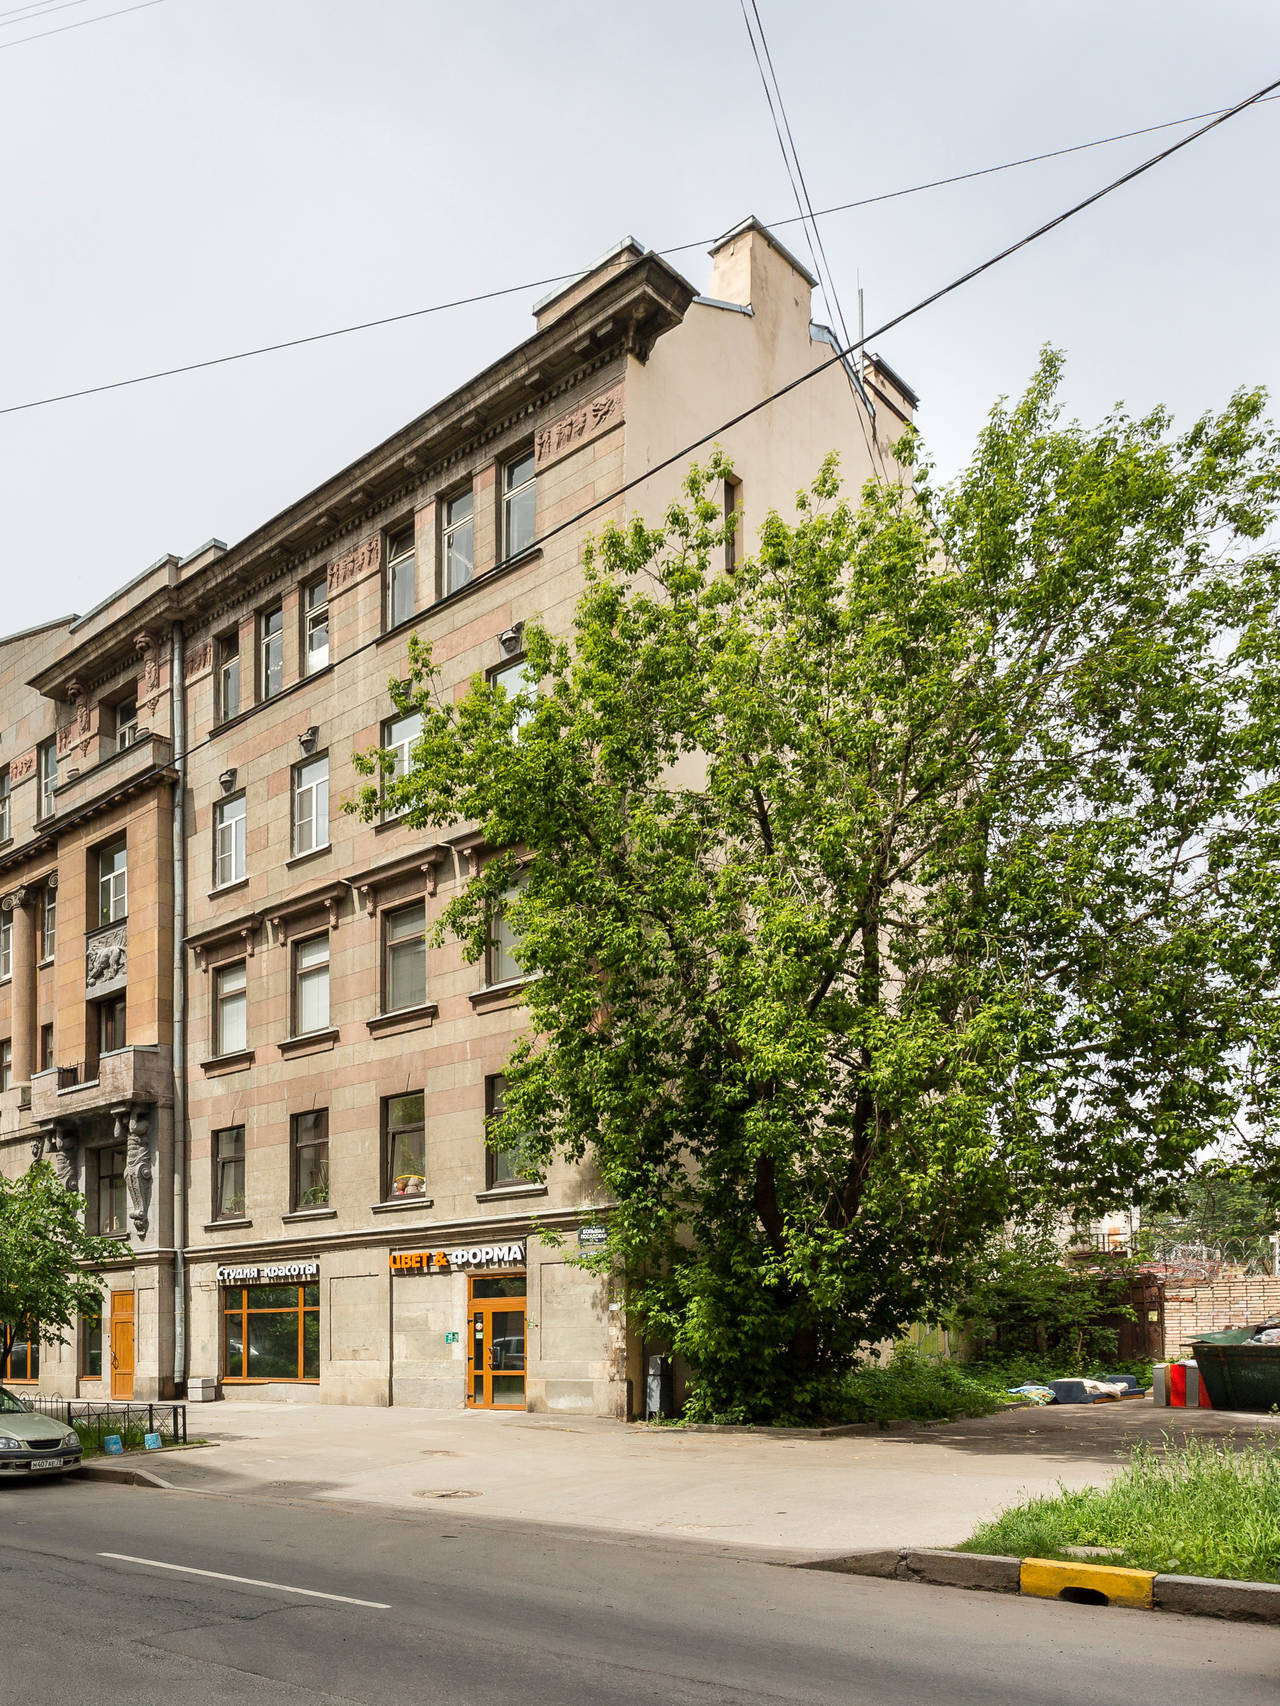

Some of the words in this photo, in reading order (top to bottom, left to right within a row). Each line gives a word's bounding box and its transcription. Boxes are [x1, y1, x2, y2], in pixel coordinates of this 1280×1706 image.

[389, 1253, 430, 1269] ЦВЕТ
[434, 1251, 449, 1267] &
[451, 1245, 523, 1265] ФОРМА
[216, 1266, 258, 1280] Студия
[263, 1264, 317, 1278] красоты
